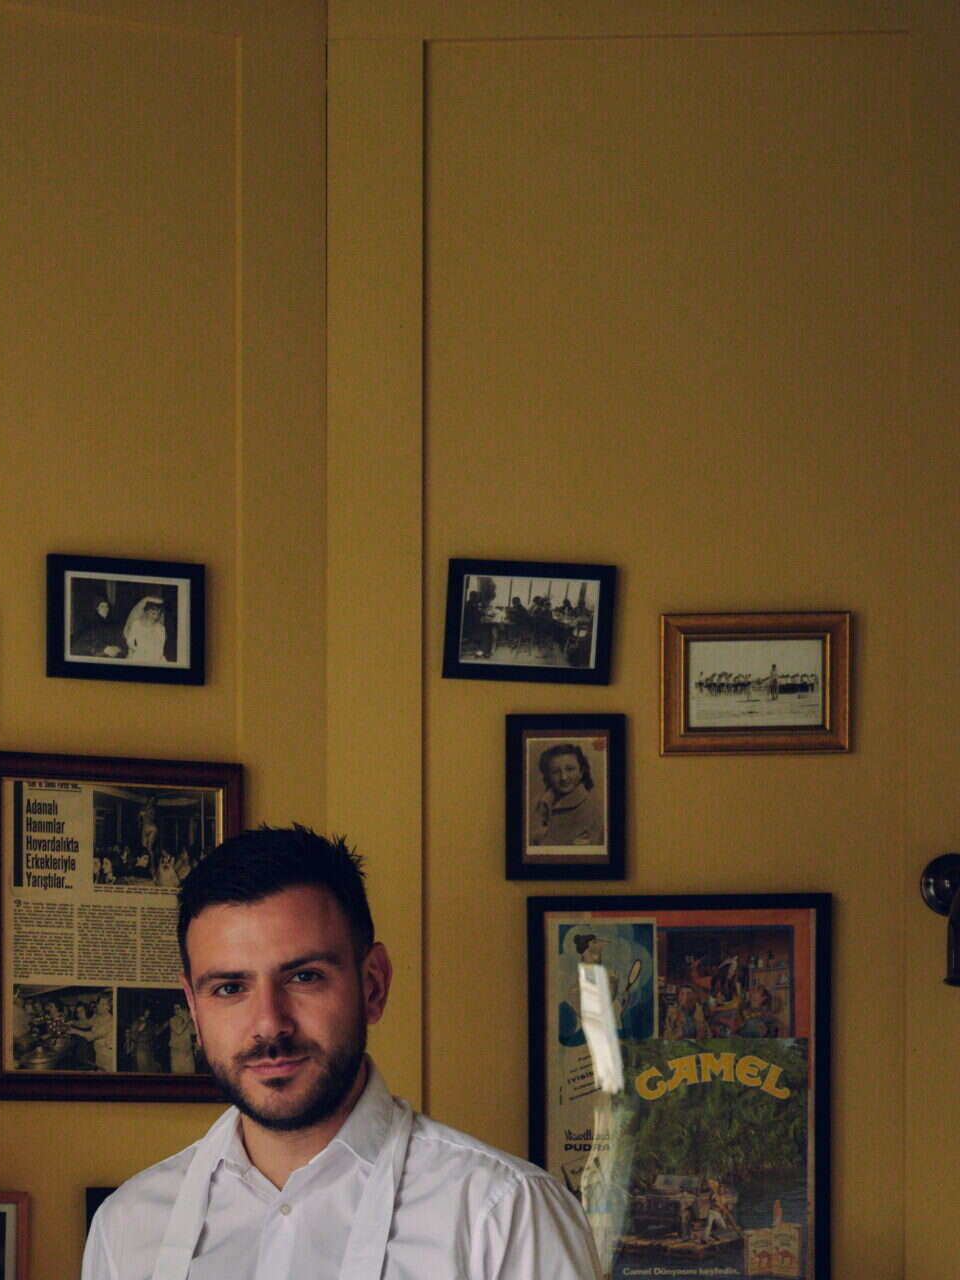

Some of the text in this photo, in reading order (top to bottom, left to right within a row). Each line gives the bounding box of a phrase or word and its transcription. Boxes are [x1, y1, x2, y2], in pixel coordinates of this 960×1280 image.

[26, 799, 58, 815] Adanalı
[26, 817, 65, 833] Hanımlar
[26, 853, 76, 872] Erkekleriyle
[635, 1052, 790, 1100] CAMEL
